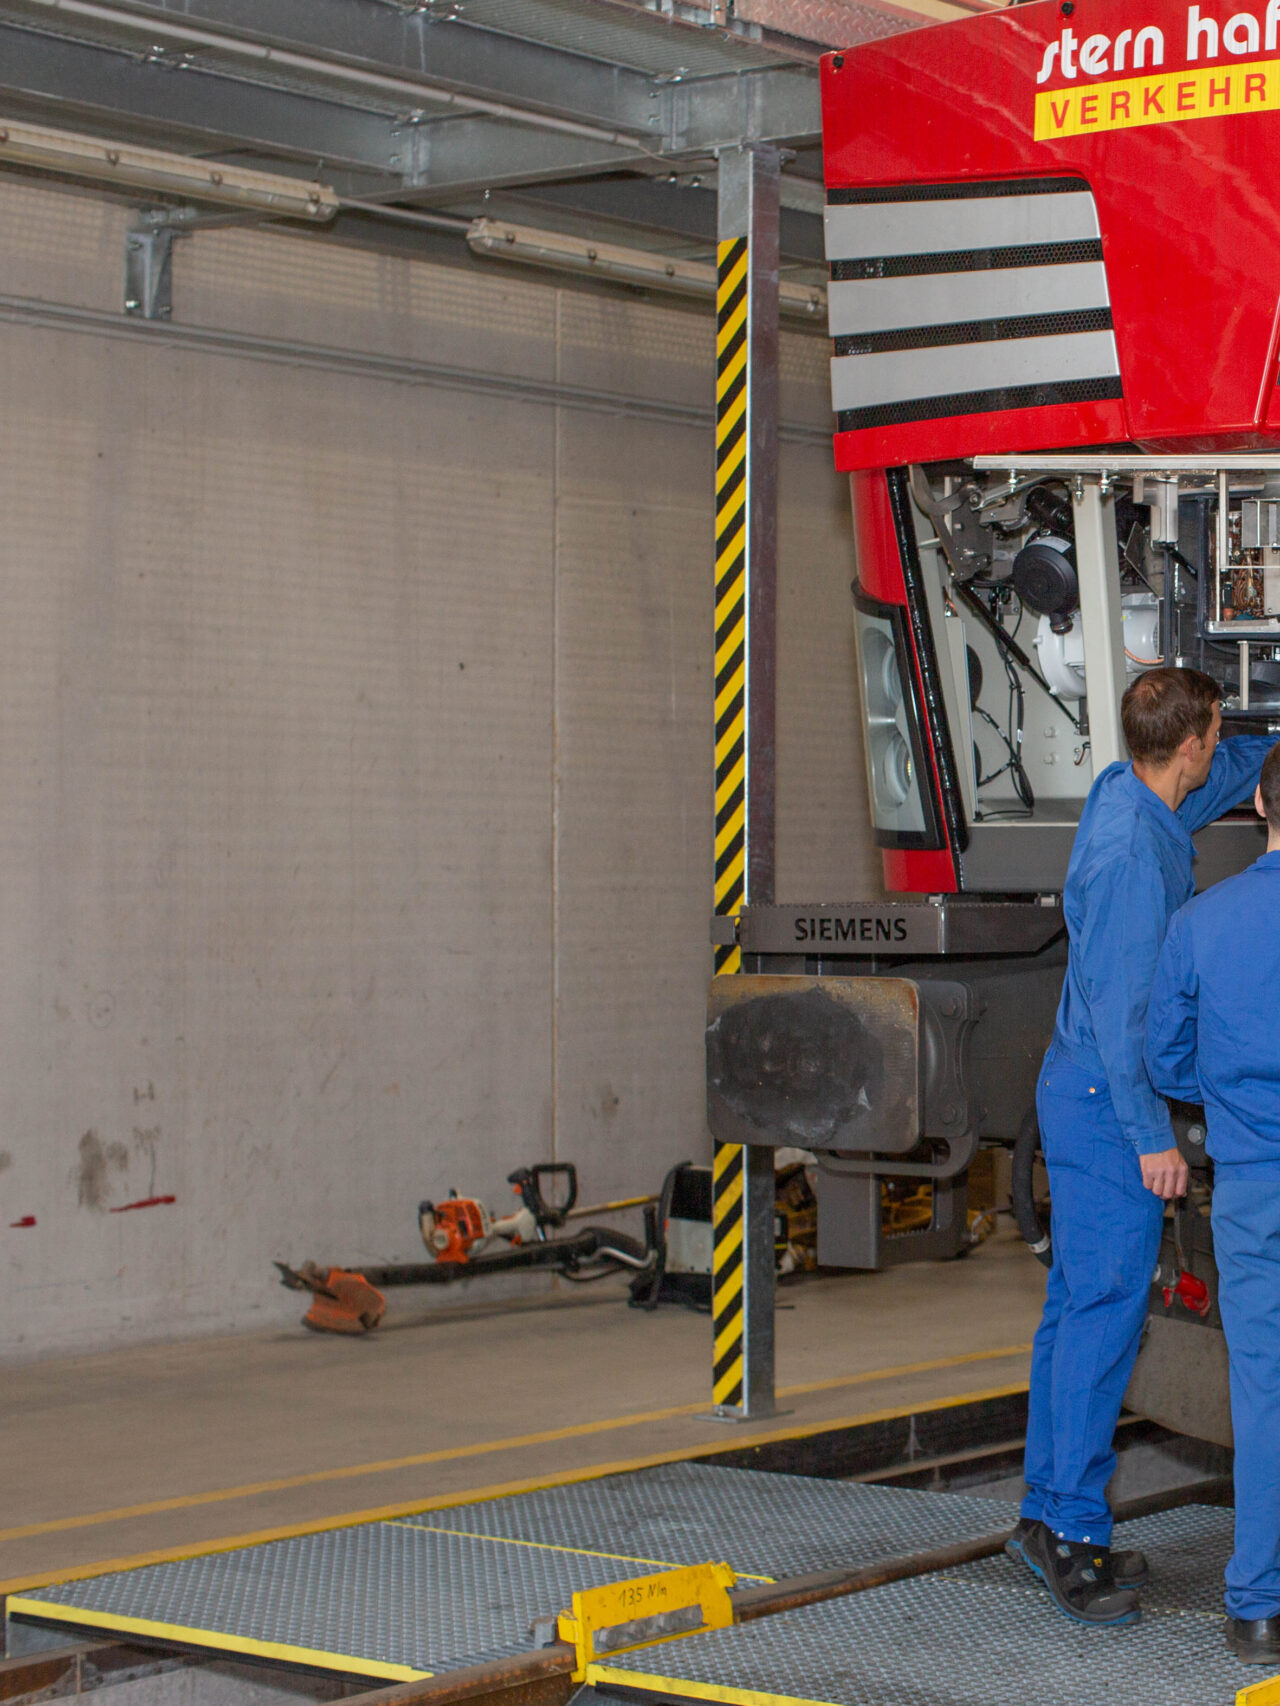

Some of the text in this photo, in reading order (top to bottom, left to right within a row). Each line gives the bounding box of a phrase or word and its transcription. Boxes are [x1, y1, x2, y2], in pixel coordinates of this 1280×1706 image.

[1036, 25, 1164, 84] stern
[1050, 73, 1266, 129] VERKEHR
[794, 917, 907, 942] SIEMENS
[619, 1587, 643, 1608] 135
